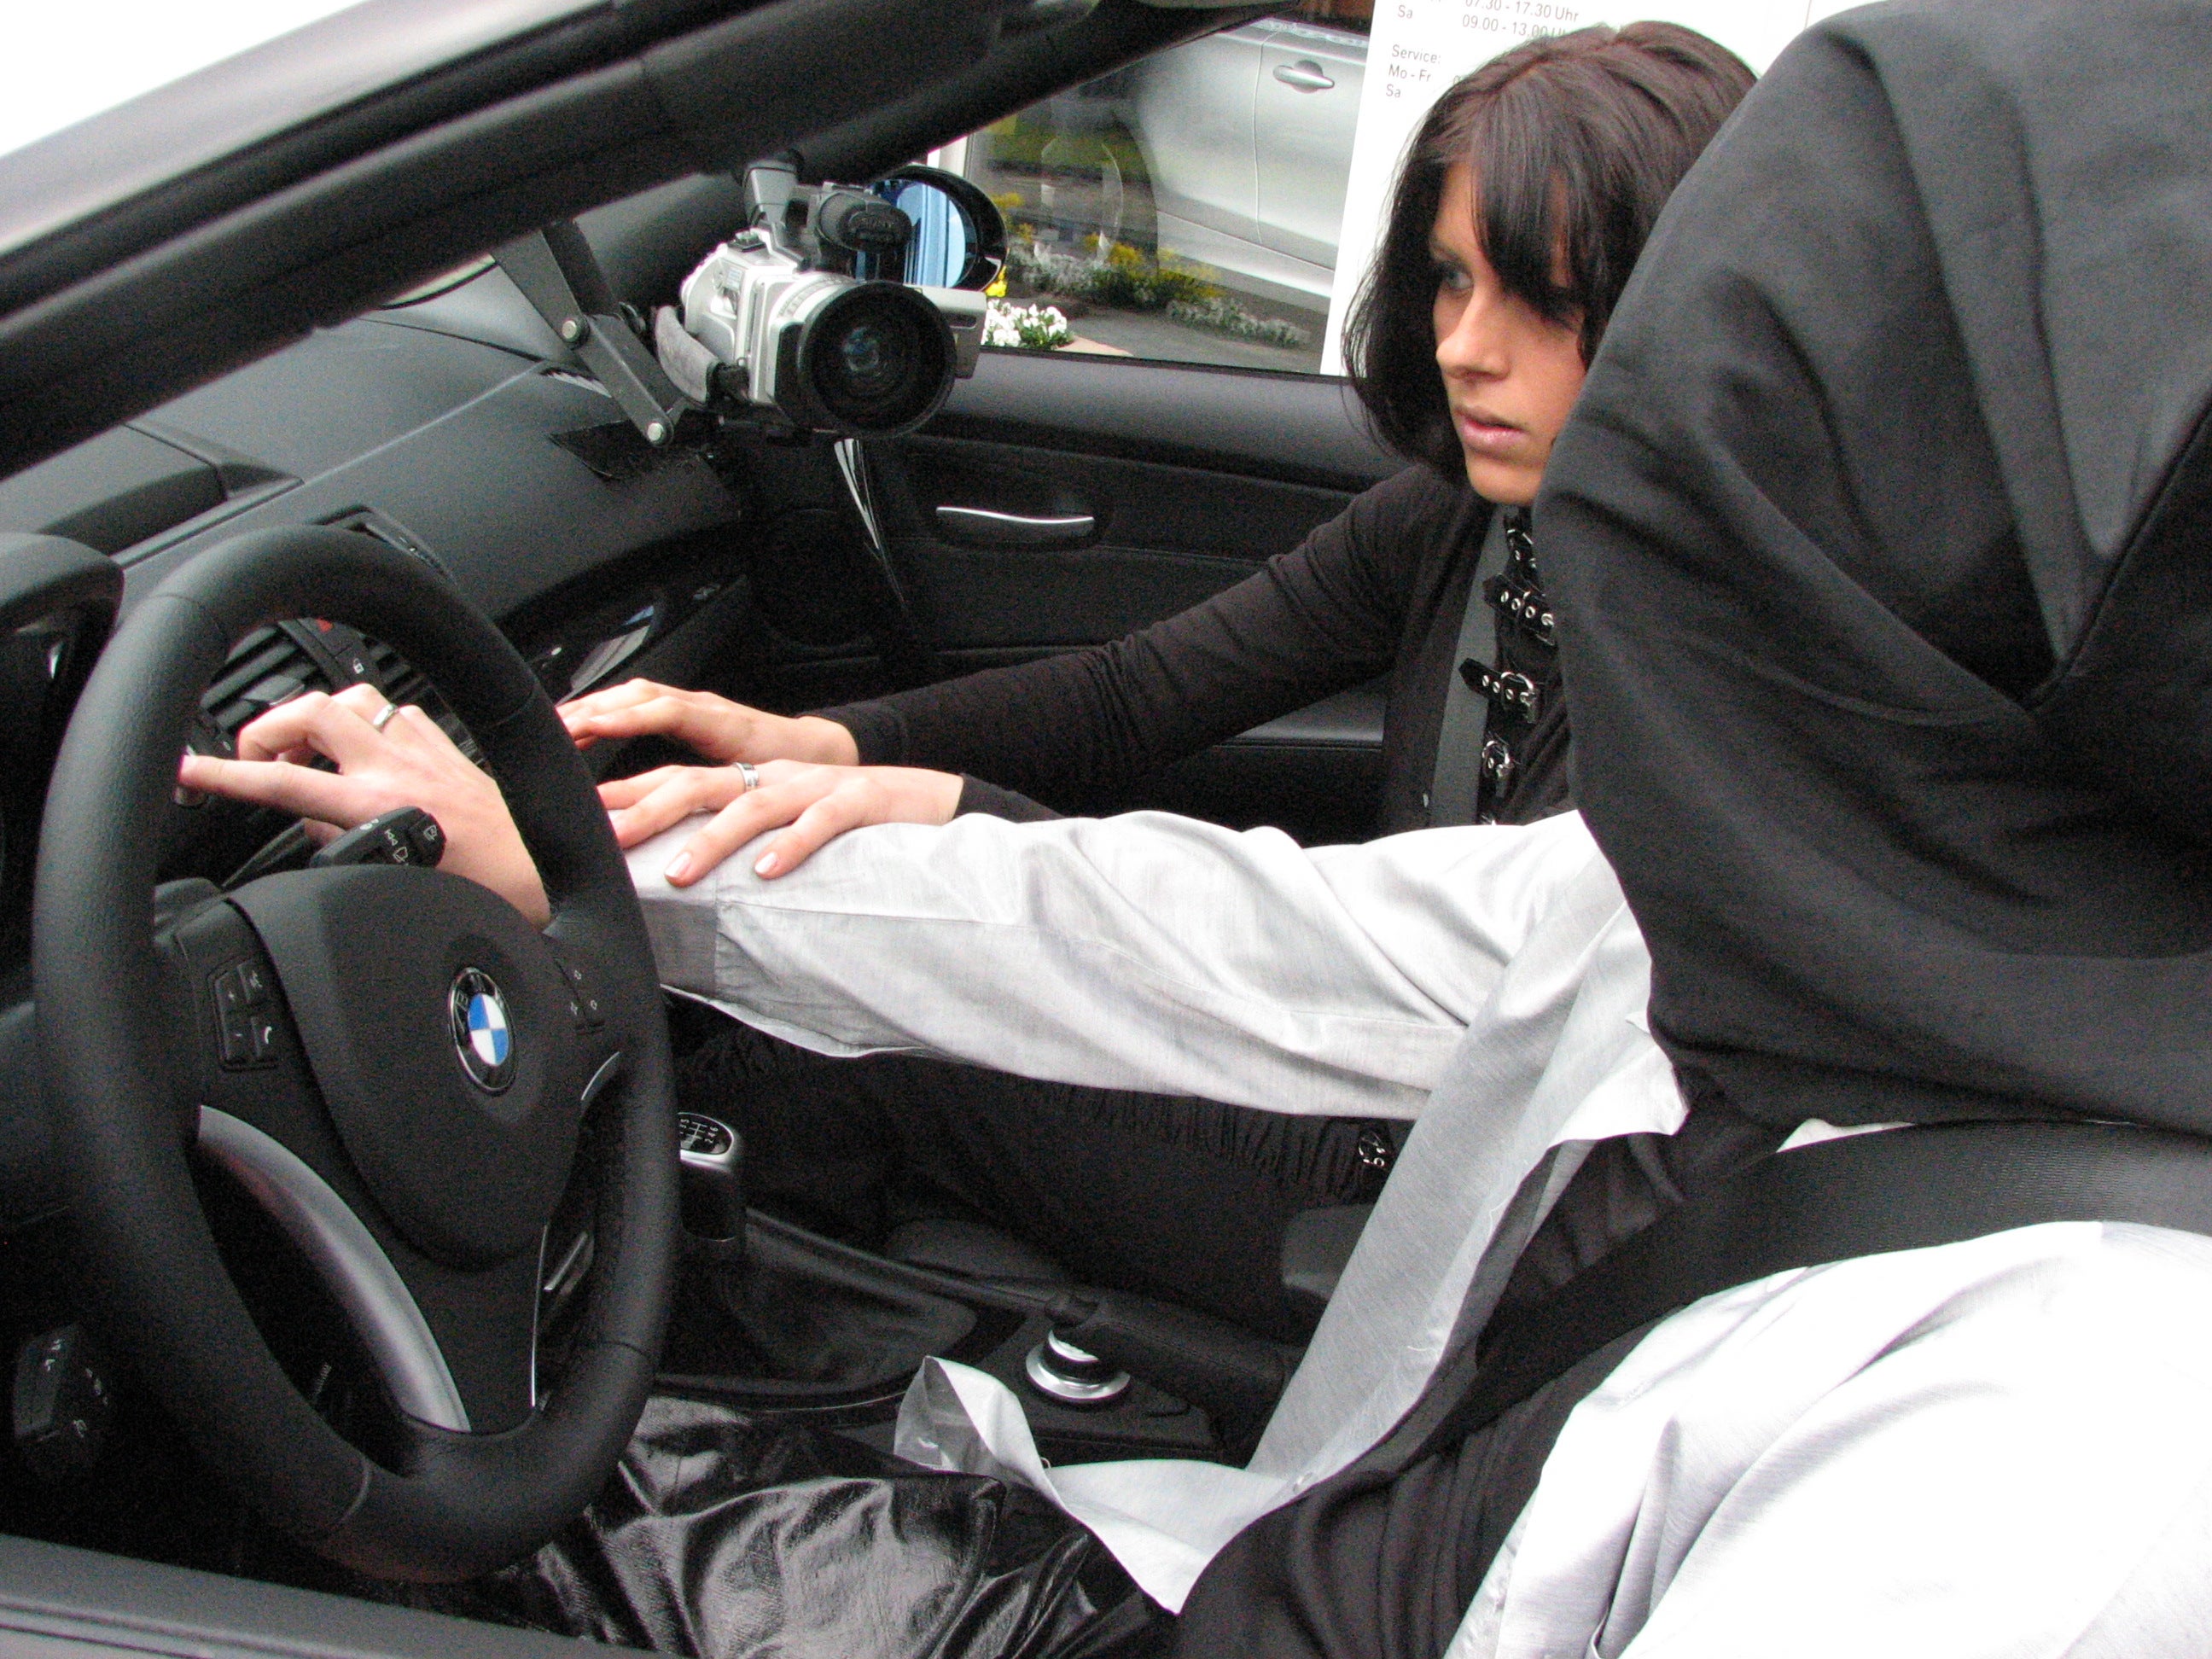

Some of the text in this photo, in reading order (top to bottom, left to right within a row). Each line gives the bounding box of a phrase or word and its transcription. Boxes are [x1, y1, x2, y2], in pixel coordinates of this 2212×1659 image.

[1397, 4, 1413, 19] Sa
[1462, 14, 1499, 32] 09.00
[1516, 1, 1552, 19] 17.30
[1555, 6, 1580, 22] Uhr
[1391, 44, 1441, 64] Service:
[1388, 63, 1407, 79] Mo
[1419, 68, 1431, 82] Fr
[1385, 83, 1401, 98] Sa
